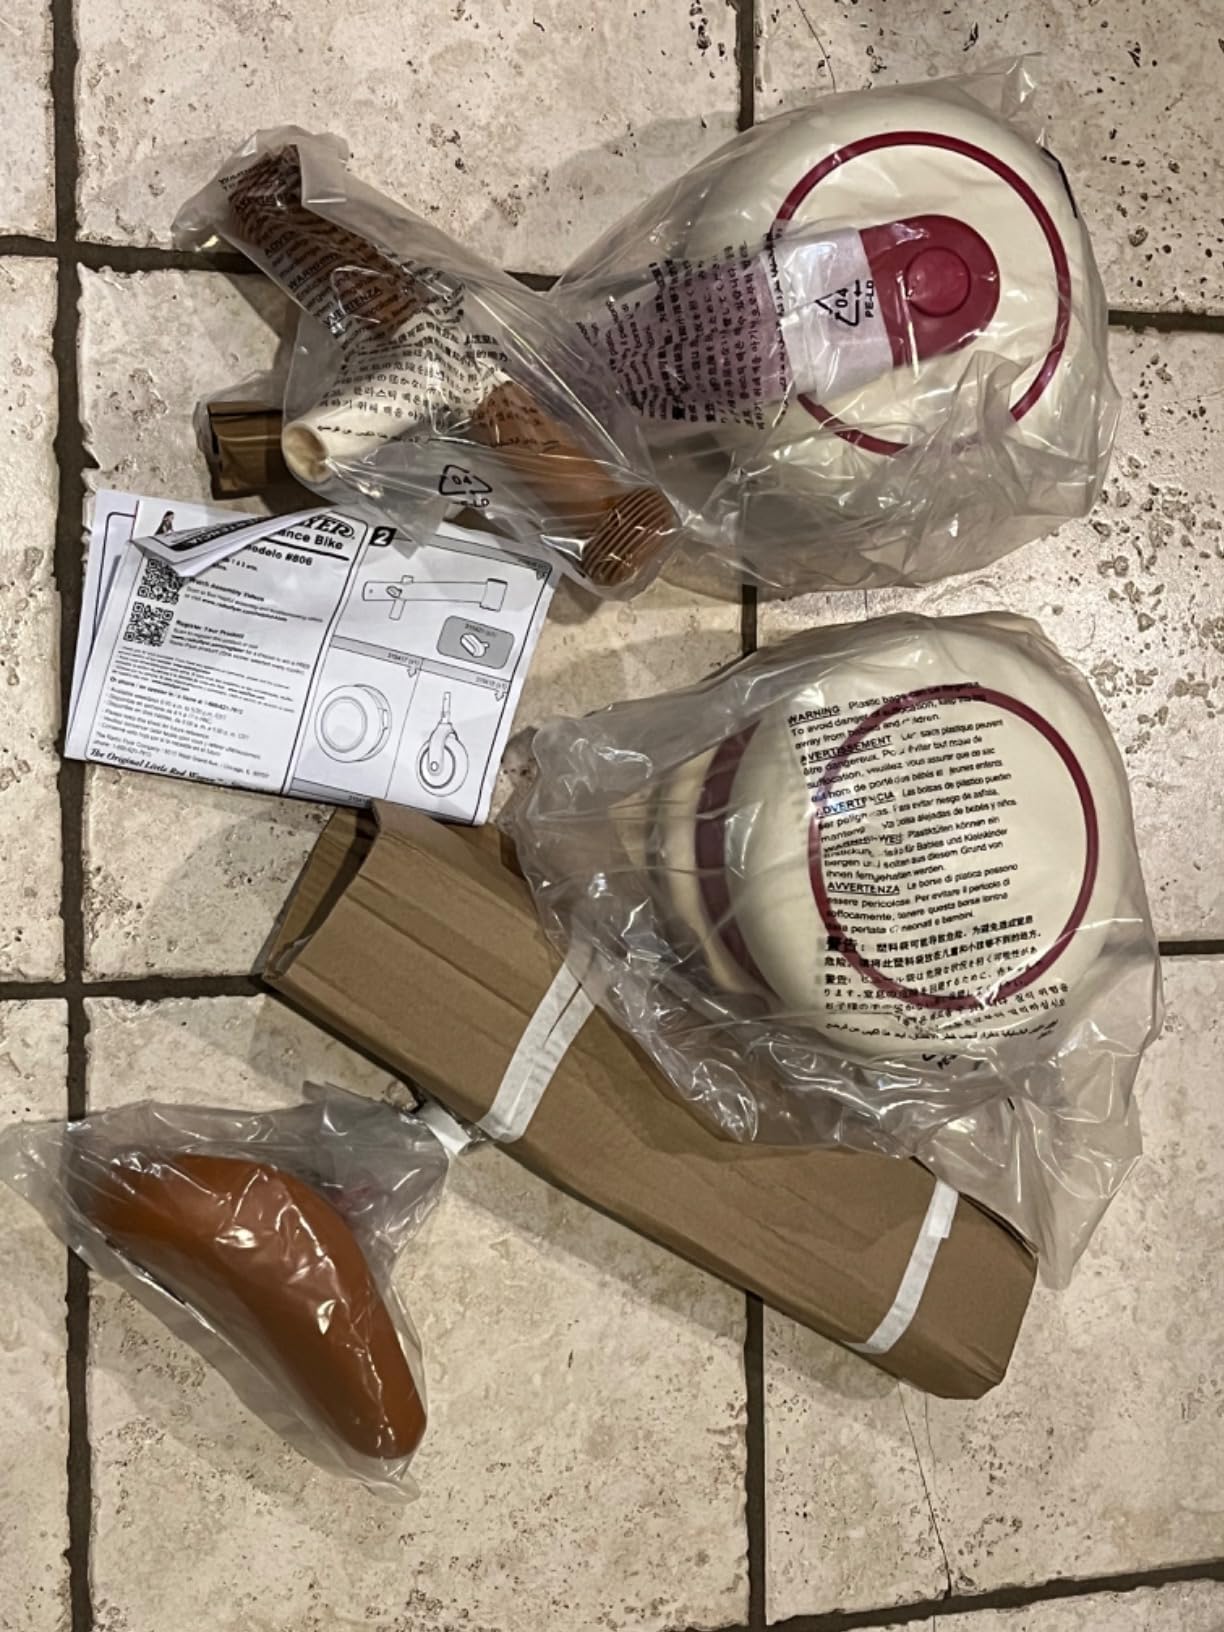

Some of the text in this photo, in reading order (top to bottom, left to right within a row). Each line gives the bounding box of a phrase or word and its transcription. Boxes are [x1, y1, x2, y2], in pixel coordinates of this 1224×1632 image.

[301, 514, 354, 539] YER
[277, 528, 311, 543] ance
[315, 533, 343, 551] Bike
[373, 529, 391, 546] 2
[285, 552, 313, 566] #806
[788, 705, 841, 727] WARNING
[848, 698, 880, 710] Plastic
[791, 728, 804, 736] To
[807, 720, 834, 733] avoid
[795, 737, 821, 750] away
[823, 731, 846, 743] from
[882, 719, 900, 729] and
[90, 748, 106, 759] The
[106, 752, 145, 767] Original
[853, 783, 867, 793] de
[946, 835, 963, 846] und
[988, 841, 1004, 850] von
[827, 881, 901, 897] AVVERTENZA
